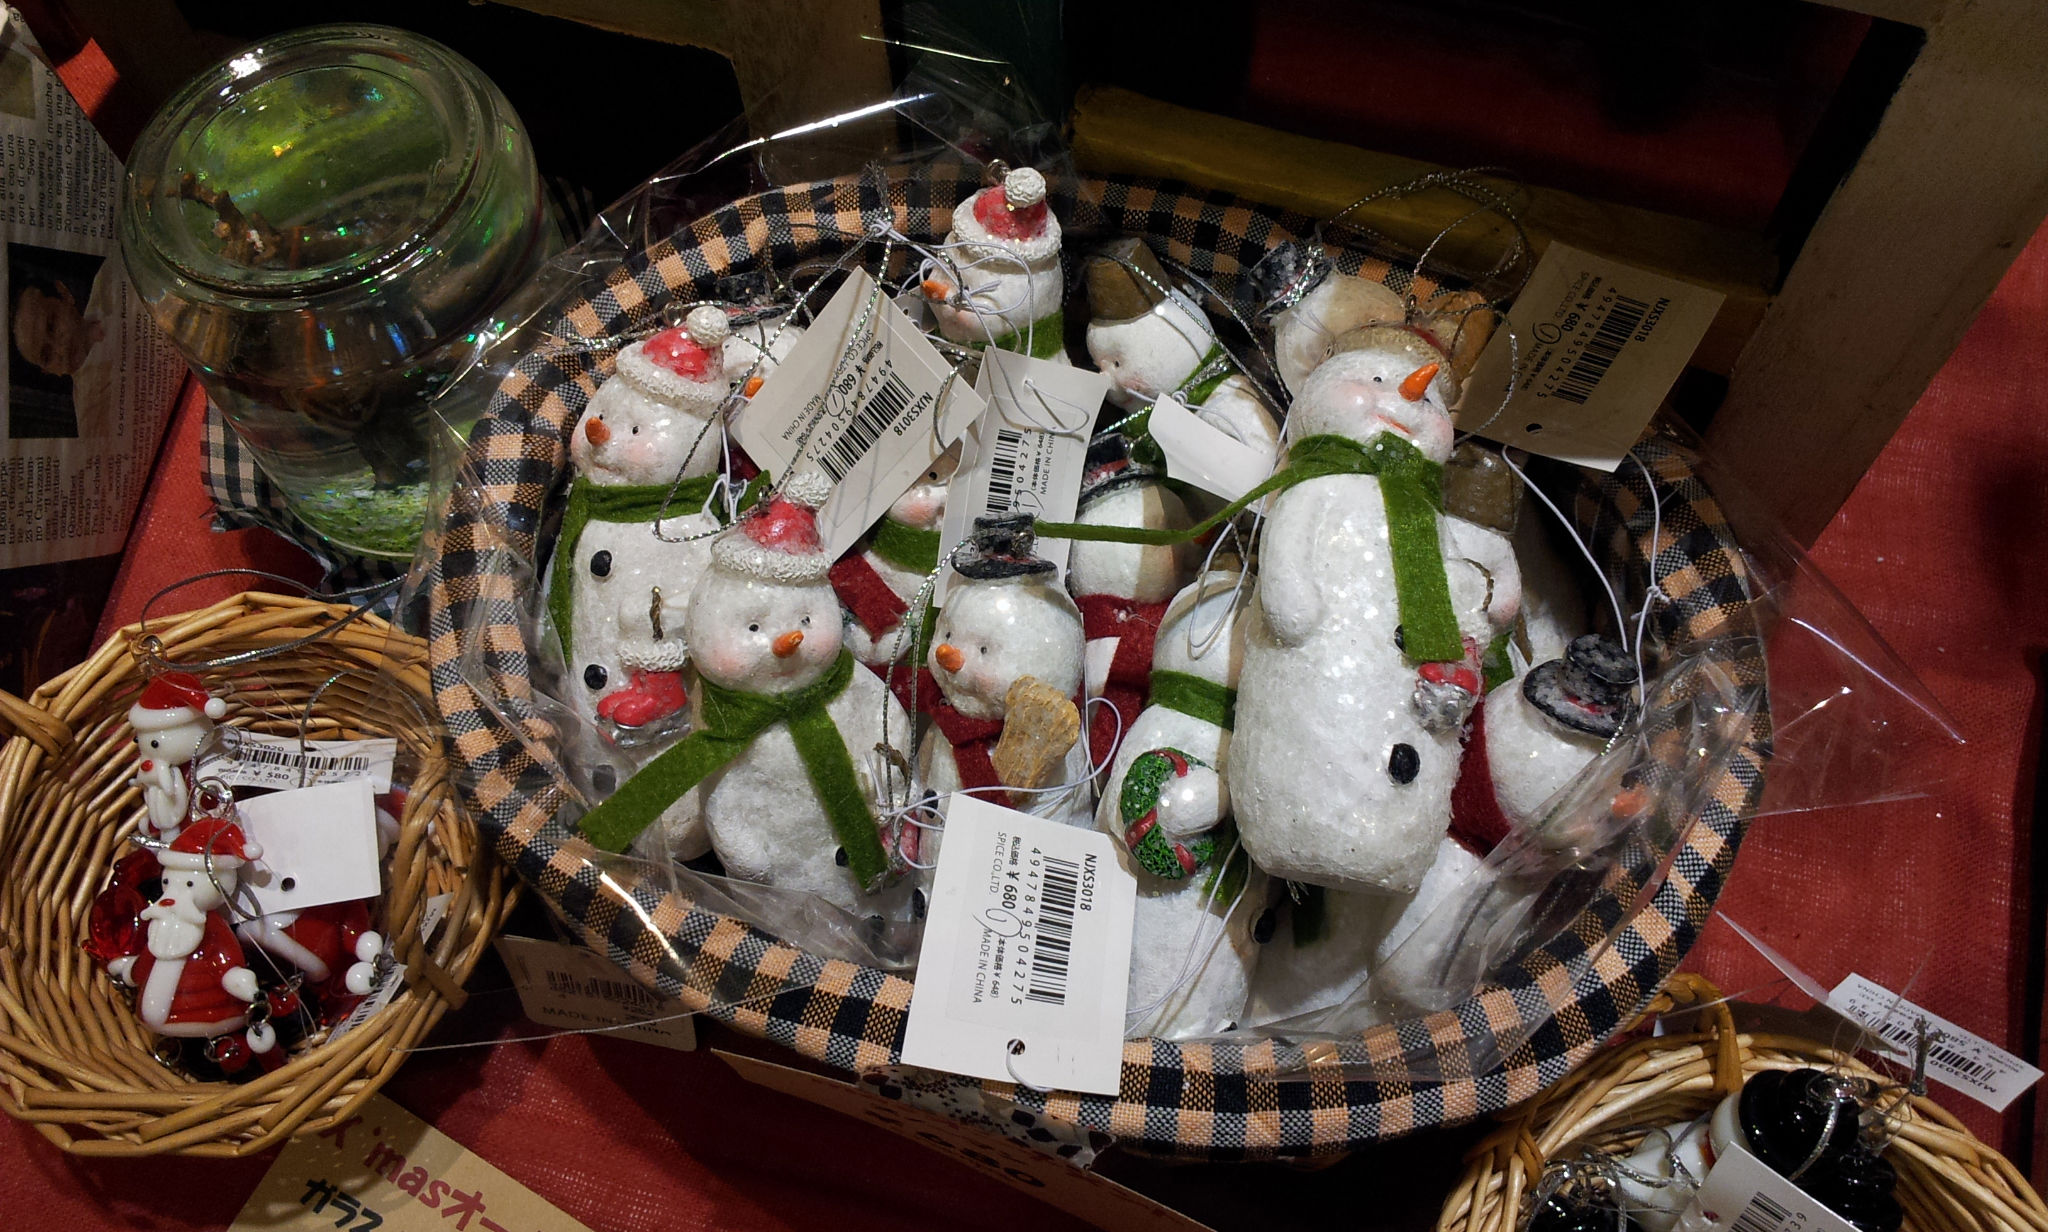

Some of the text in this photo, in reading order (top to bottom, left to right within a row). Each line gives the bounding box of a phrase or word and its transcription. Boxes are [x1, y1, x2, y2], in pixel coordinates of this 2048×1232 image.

[7, 135, 15, 157] una
[17, 136, 25, 170] ospiti
[17, 176, 25, 187] di
[28, 207, 36, 226] per
[1634, 297, 1670, 342] NJXS3018
[781, 419, 800, 440] CHINA
[893, 392, 934, 436] NJXS3018
[1013, 428, 1032, 508] 9504275
[1040, 426, 1056, 494] MADE IN CHIN
[995, 832, 1007, 856] SPICE
[1080, 853, 1097, 911] NJXS3018
[1010, 847, 1041, 1005] 4947849504275
[973, 927, 992, 1003] MADE IN CHINA
